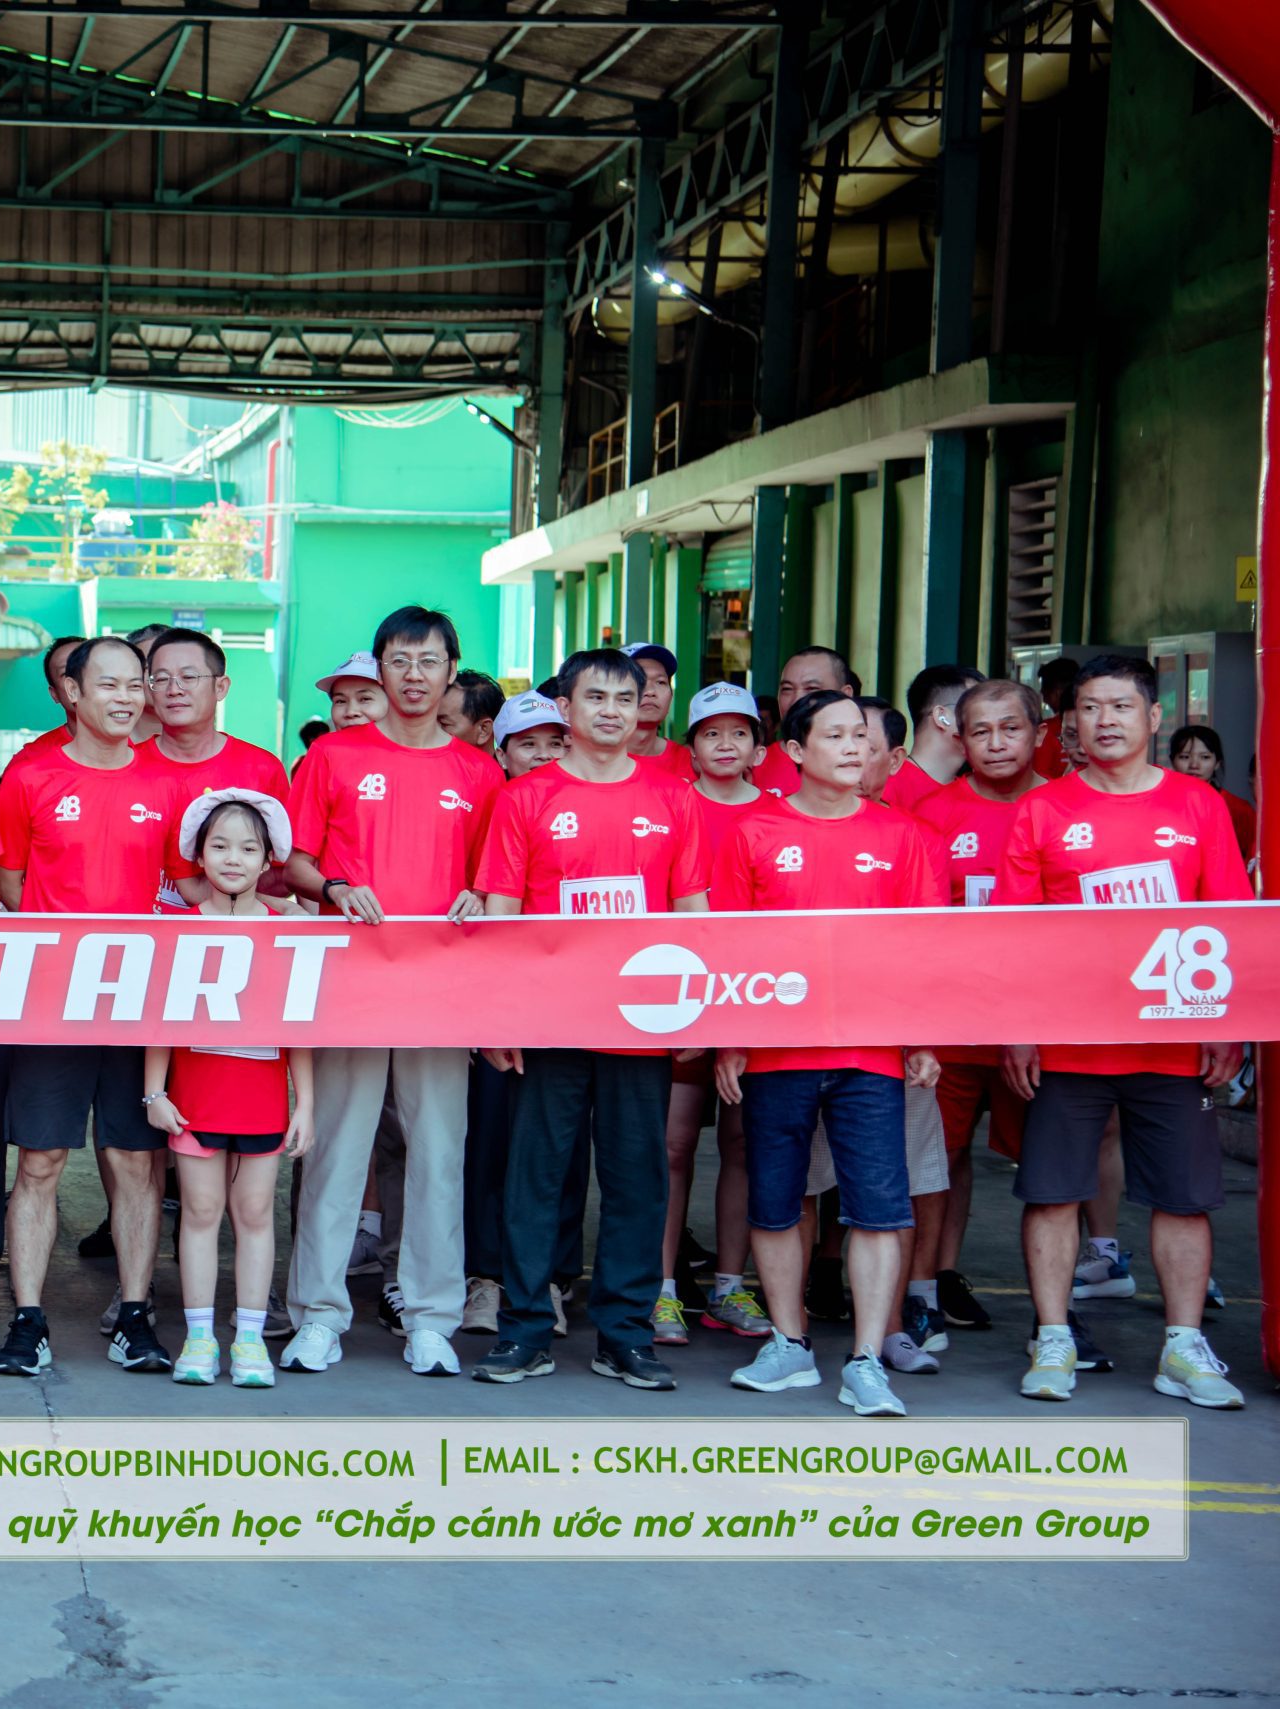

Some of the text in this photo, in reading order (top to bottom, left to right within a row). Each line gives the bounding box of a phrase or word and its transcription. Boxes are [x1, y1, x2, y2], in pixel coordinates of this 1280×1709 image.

[357, 773, 386, 797] 48
[54, 795, 80, 817] 48
[549, 811, 579, 834] 48
[1062, 822, 1093, 846] 48
[950, 832, 979, 855] 48
[775, 845, 803, 868] 48
[1129, 925, 1233, 1007] 48
[1150, 1007, 1175, 1017] 1977
[1189, 1006, 1218, 1016] 2025
